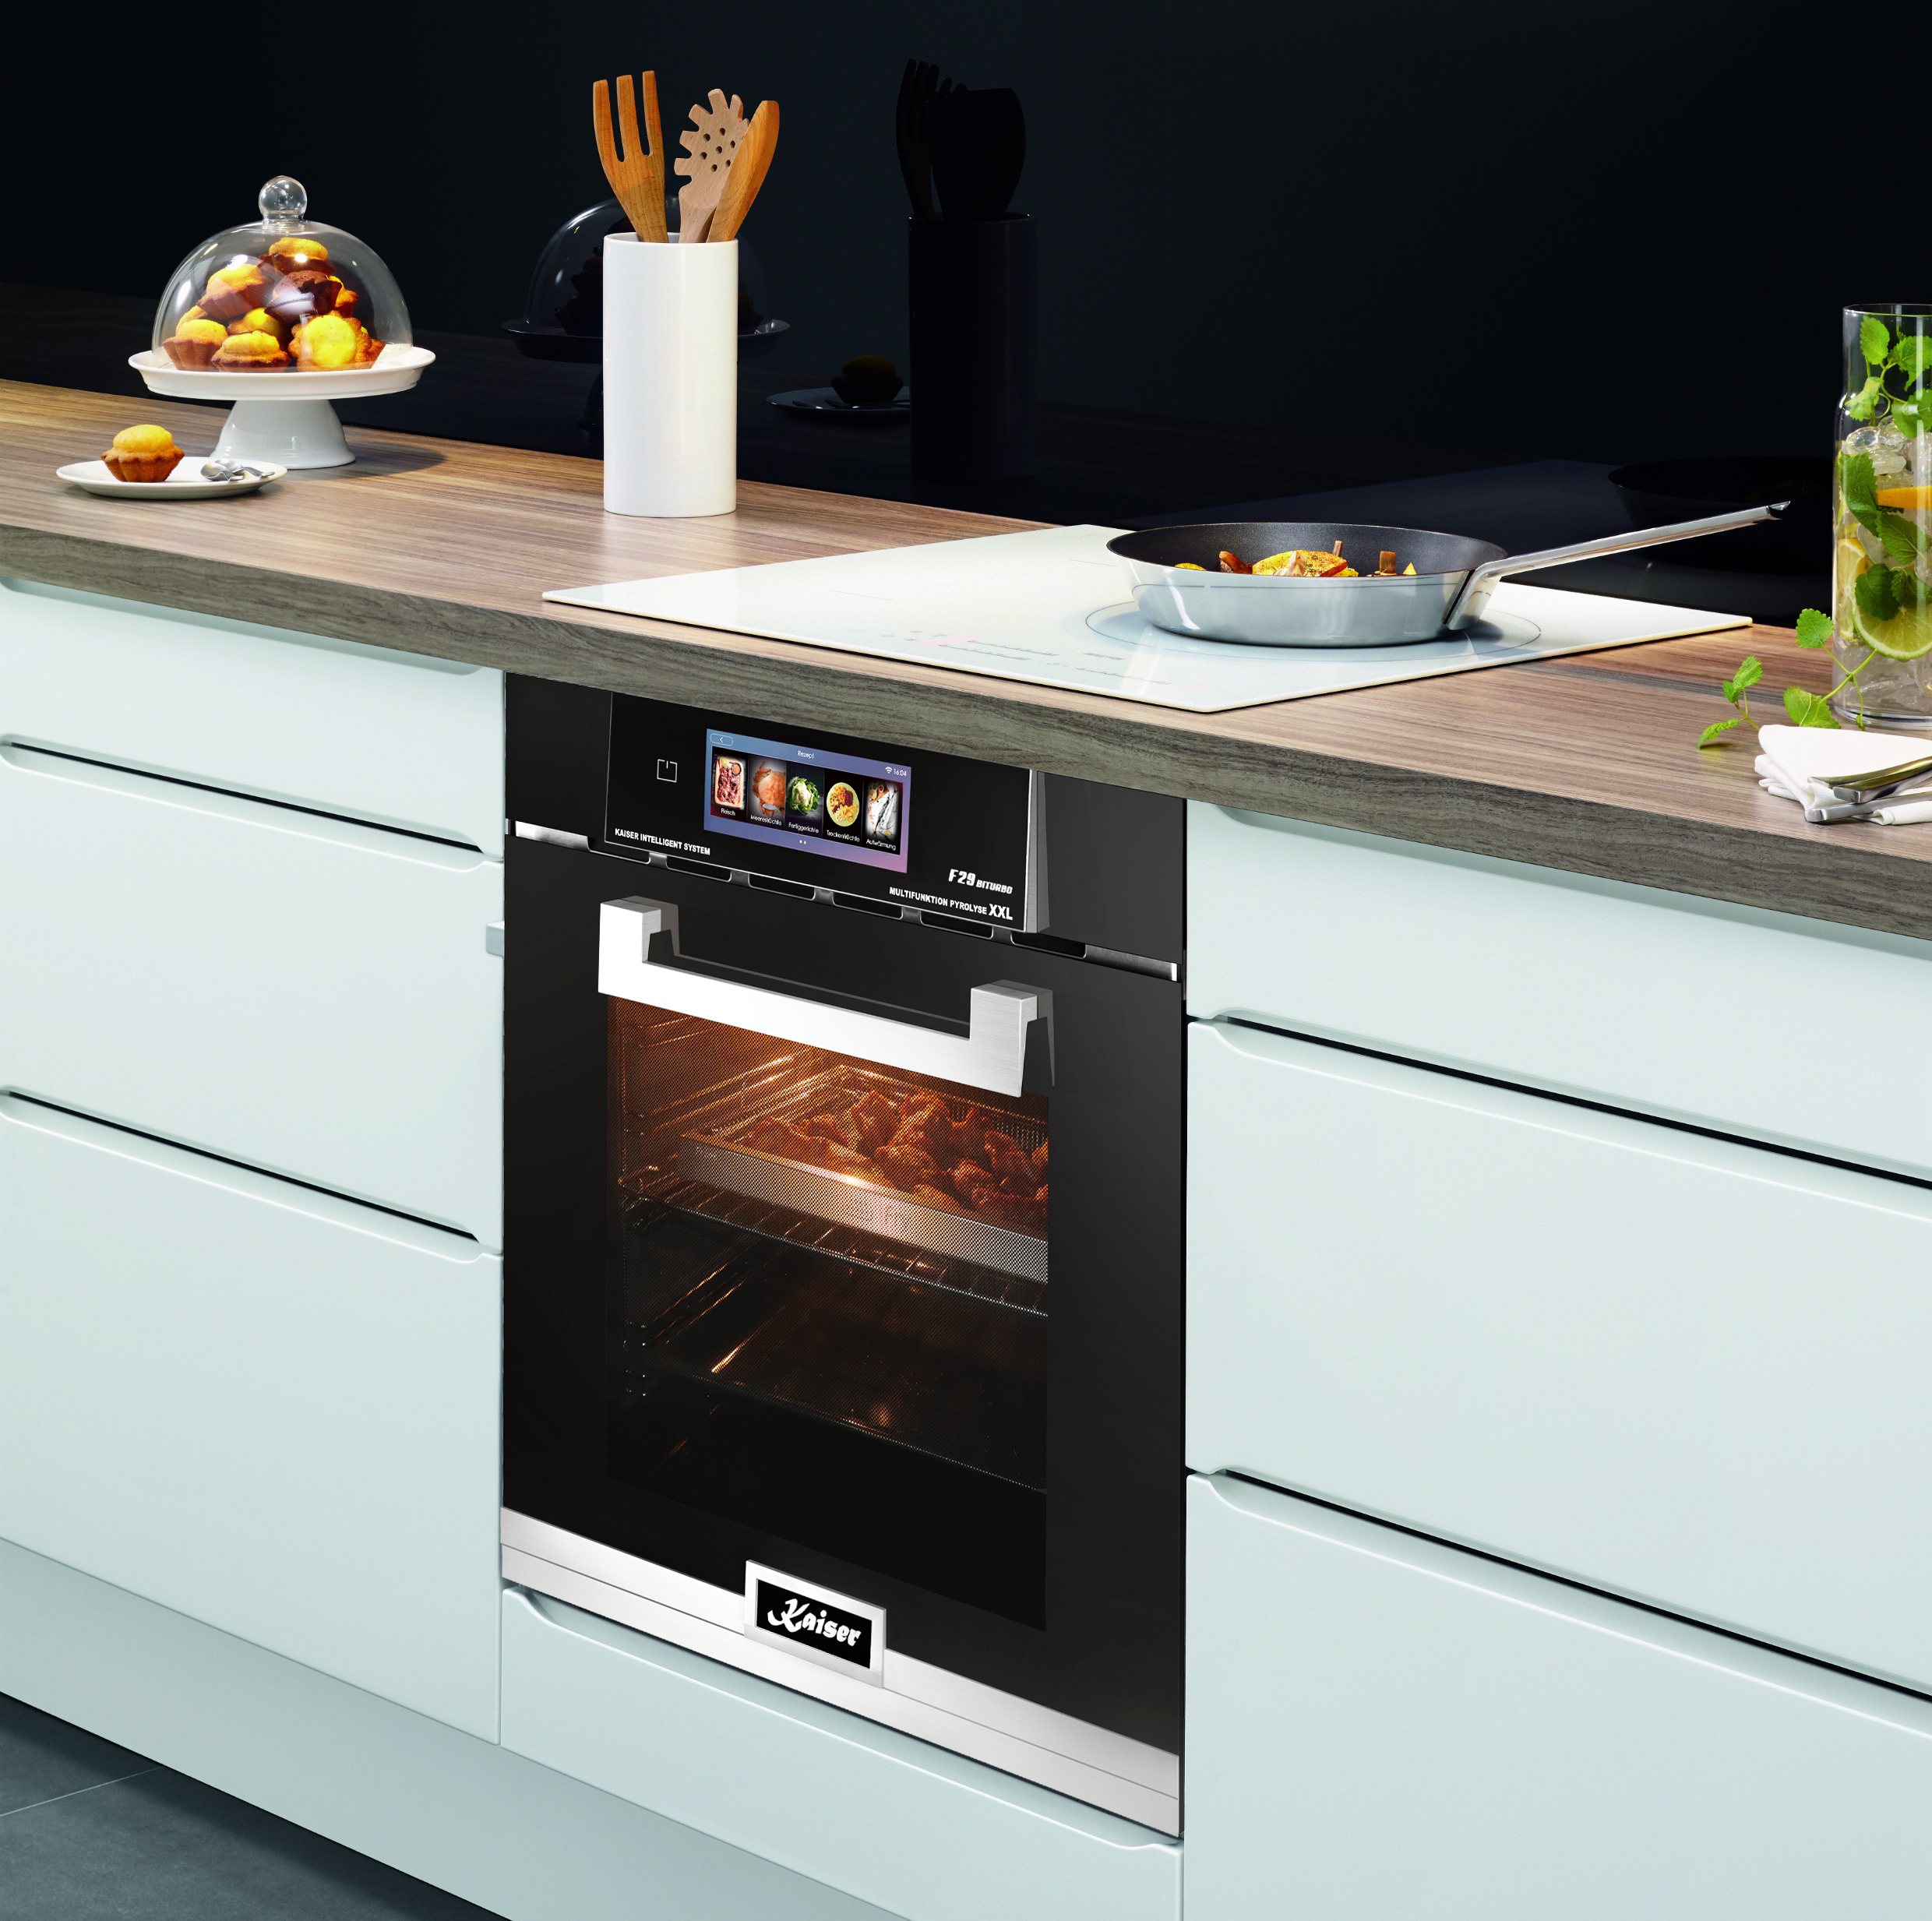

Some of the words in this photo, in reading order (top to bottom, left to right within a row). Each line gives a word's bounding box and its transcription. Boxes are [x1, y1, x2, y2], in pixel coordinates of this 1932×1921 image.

[797, 750, 814, 760] Rezept
[894, 768, 907, 777] 16:04
[615, 828, 639, 841] KAISER
[640, 833, 682, 849] INTELLIGENT
[683, 842, 710, 855] SYSTEM
[975, 879, 1013, 894] BITURBO
[889, 886, 948, 907] MULTIFUNKTION
[950, 899, 987, 915] PYROLYSE
[989, 903, 1013, 921] XXL
[767, 1598, 862, 1647] Kaiser
